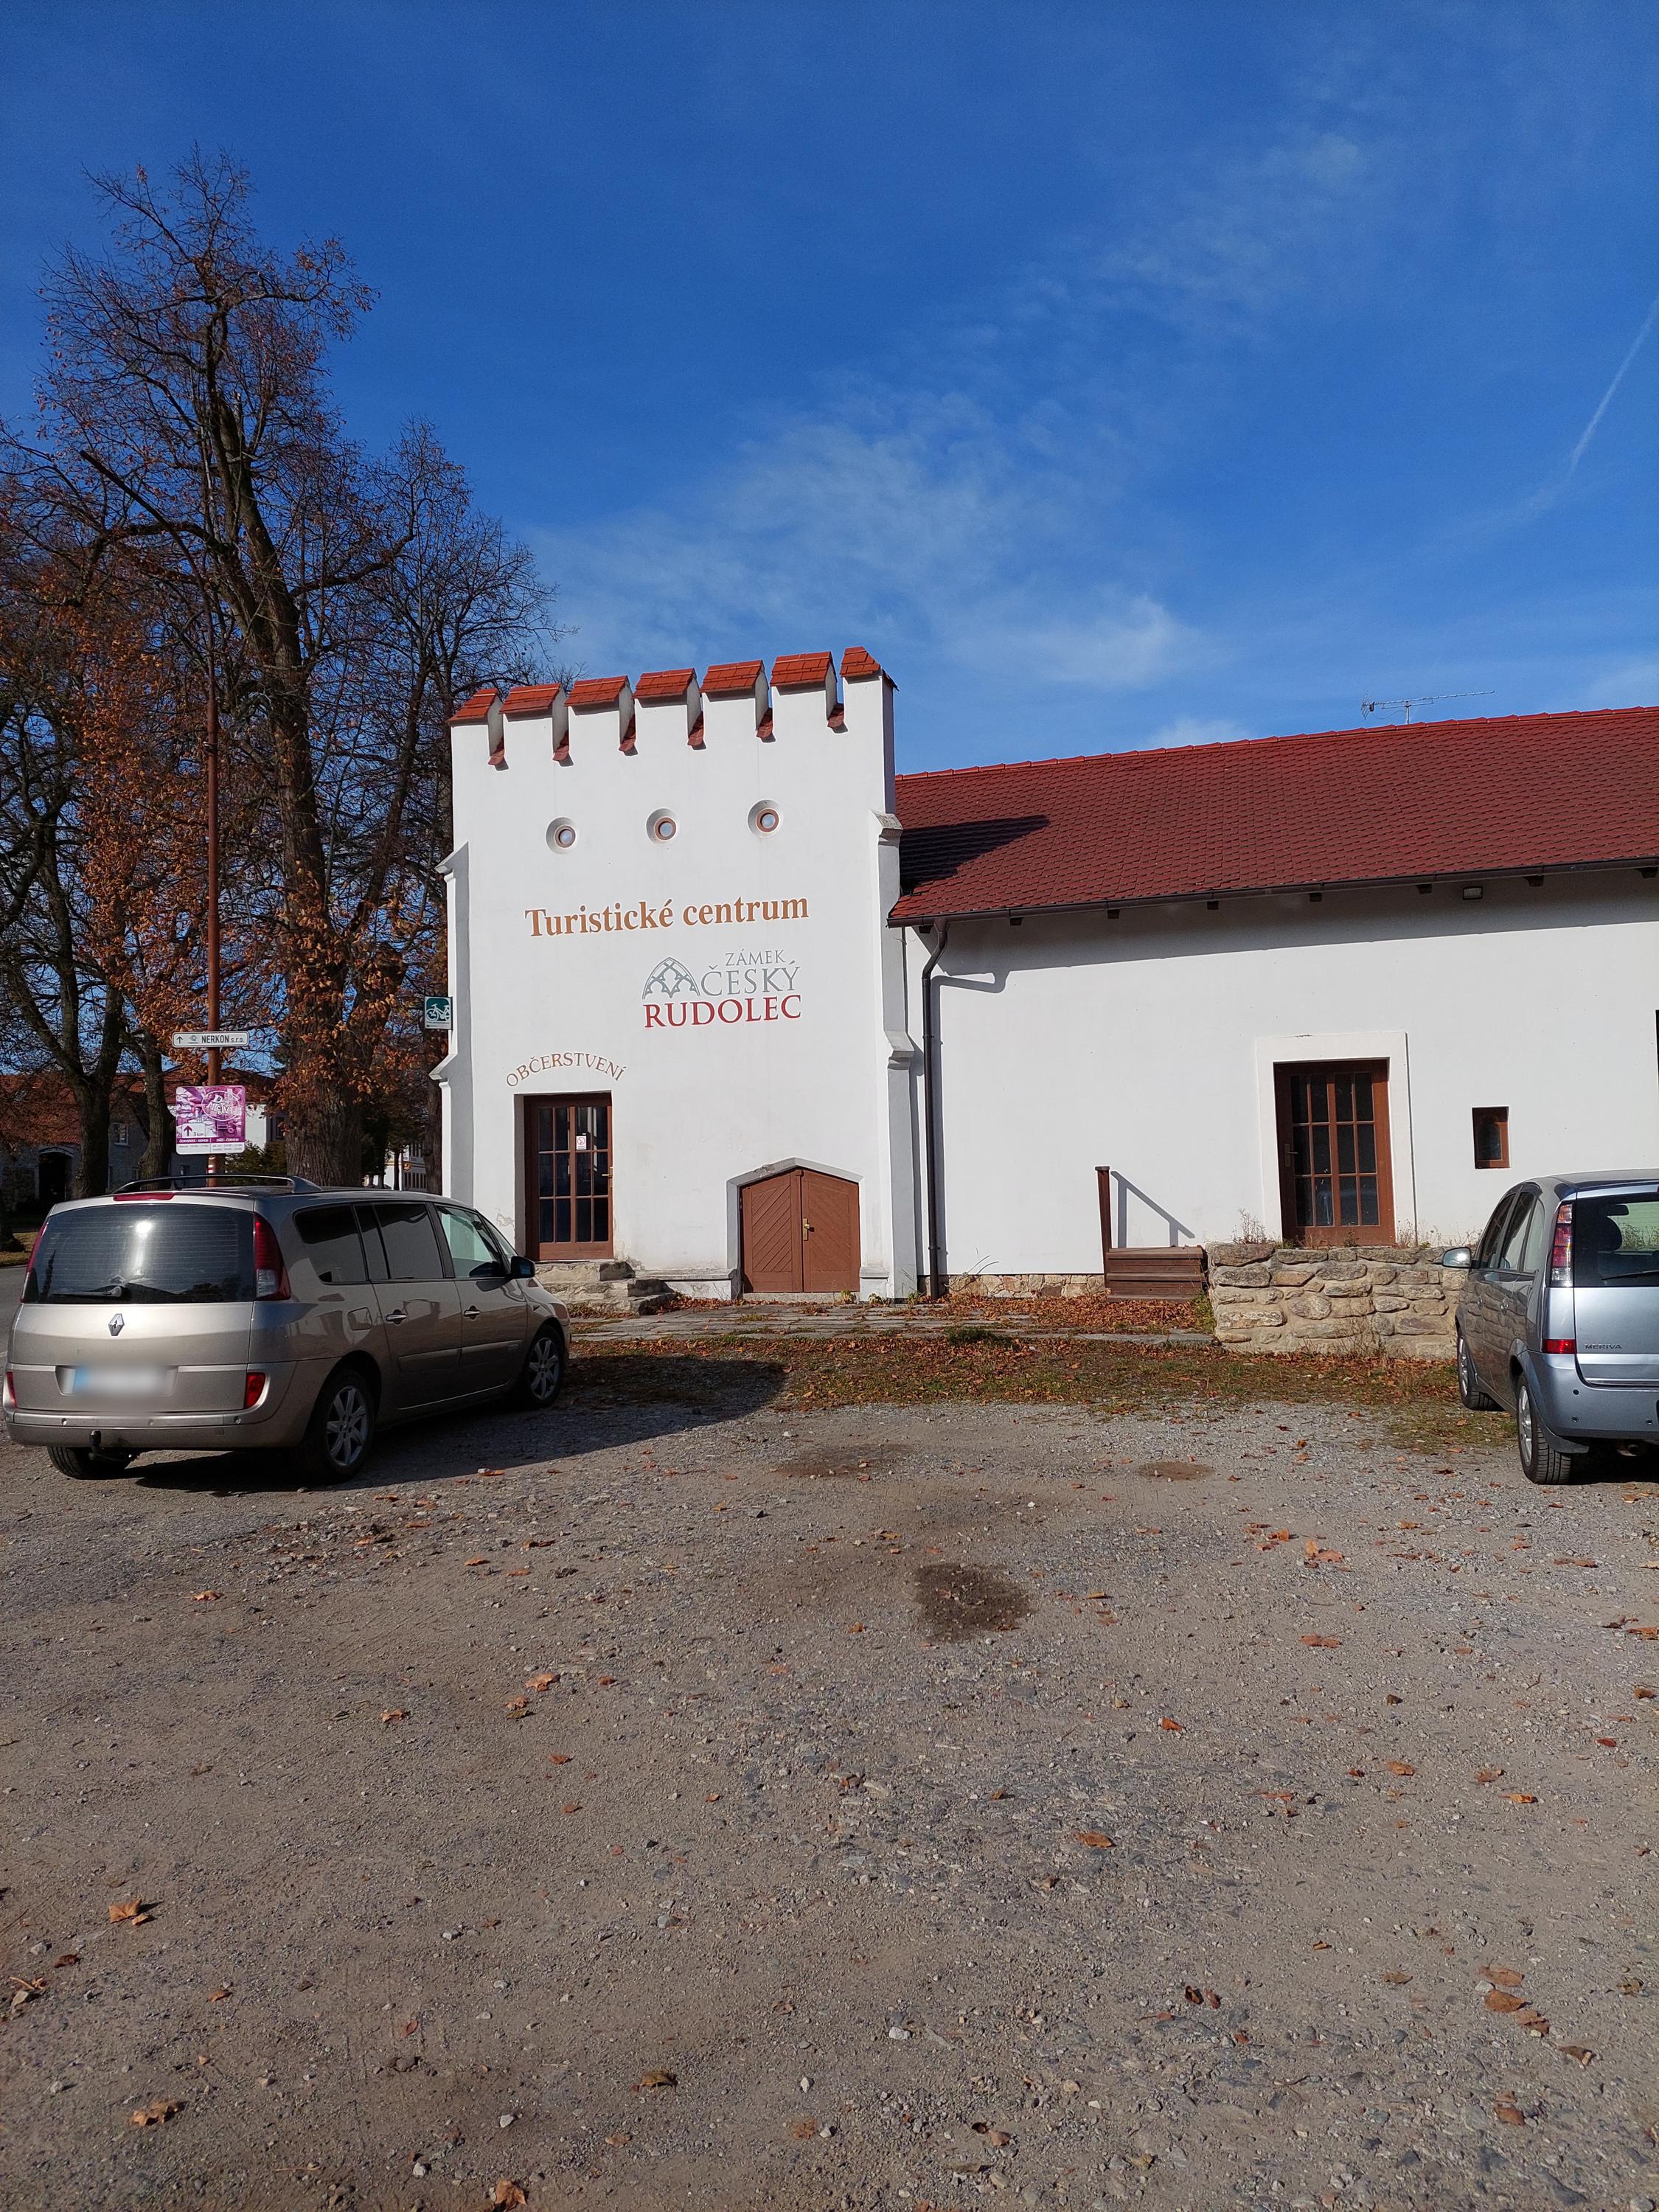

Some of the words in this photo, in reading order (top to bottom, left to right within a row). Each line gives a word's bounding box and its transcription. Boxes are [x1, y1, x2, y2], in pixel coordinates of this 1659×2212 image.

[525, 899, 674, 937] Turistické
[683, 897, 809, 926] centrum
[725, 948, 787, 967] ZÁMEK
[700, 961, 801, 996] ČESKÝ
[643, 995, 801, 1029] RUDOLEC
[201, 1034, 229, 1043] NERKON
[507, 1052, 627, 1088] OBČERSTVENÍ
